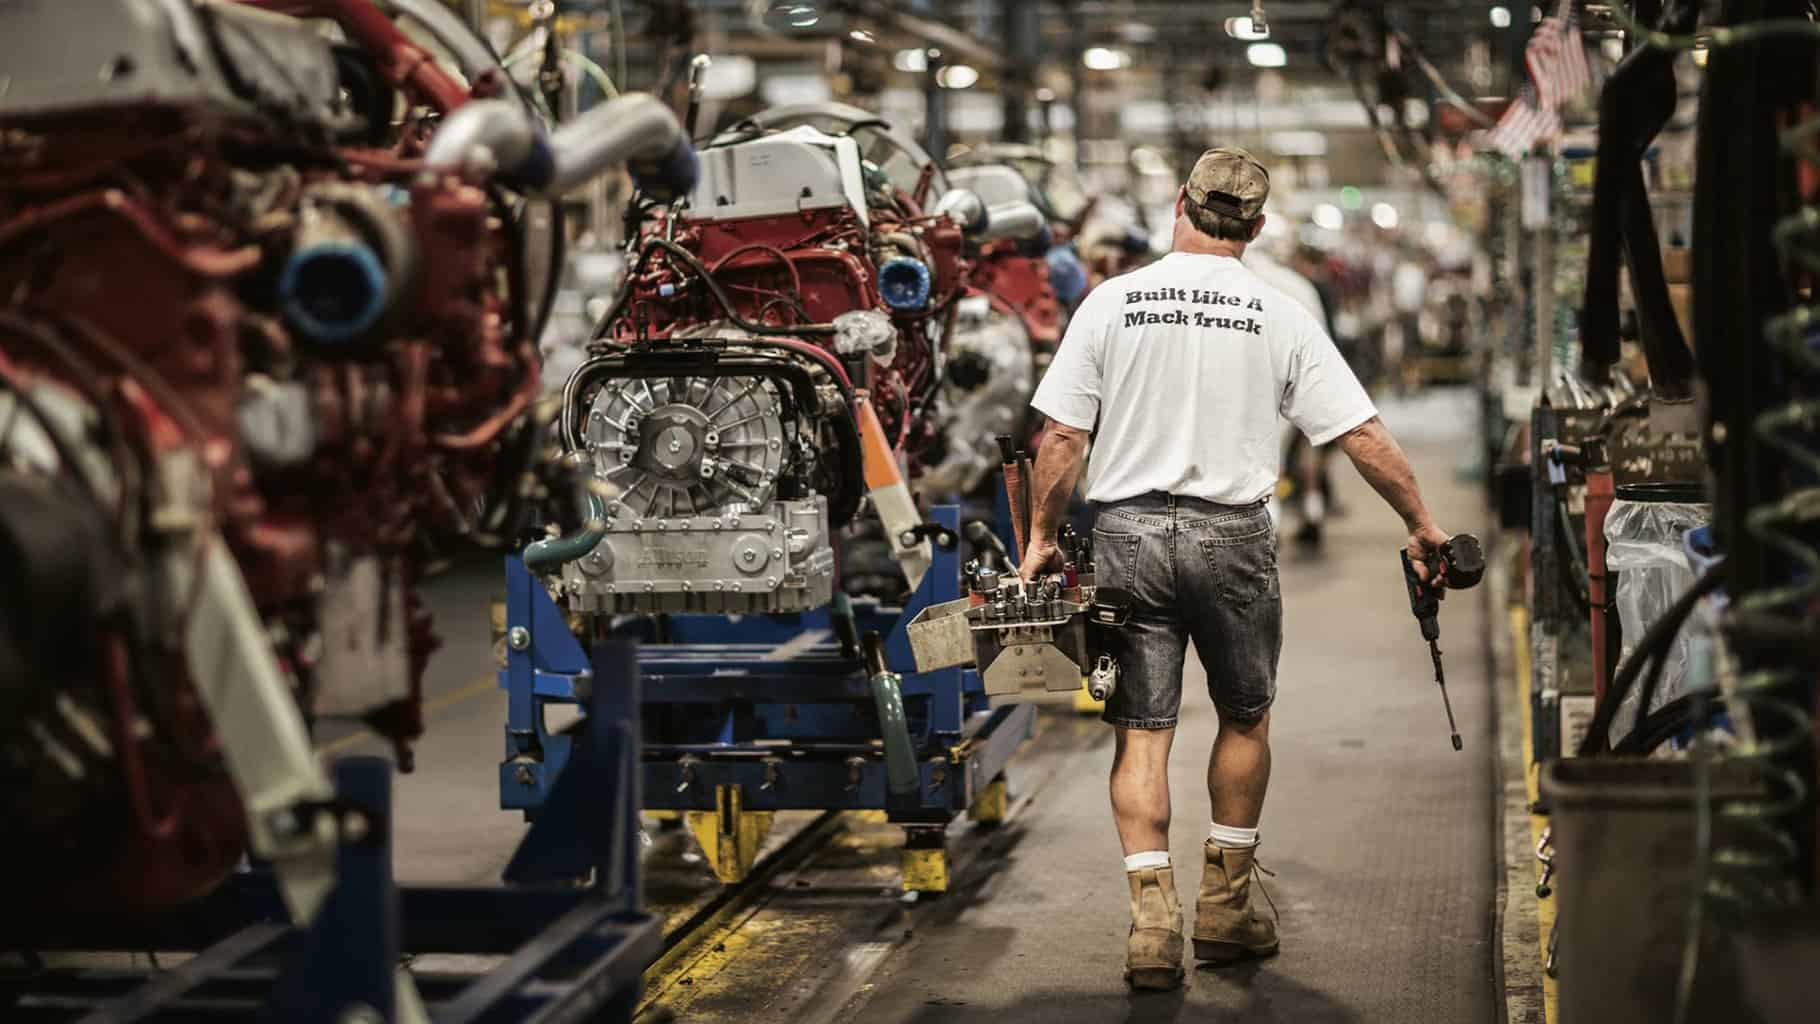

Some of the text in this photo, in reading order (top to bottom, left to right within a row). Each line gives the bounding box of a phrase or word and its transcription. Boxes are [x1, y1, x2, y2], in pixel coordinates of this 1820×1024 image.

[1126, 288, 1263, 312] Built Like A
[1124, 310, 1262, 335] Mack Truck
